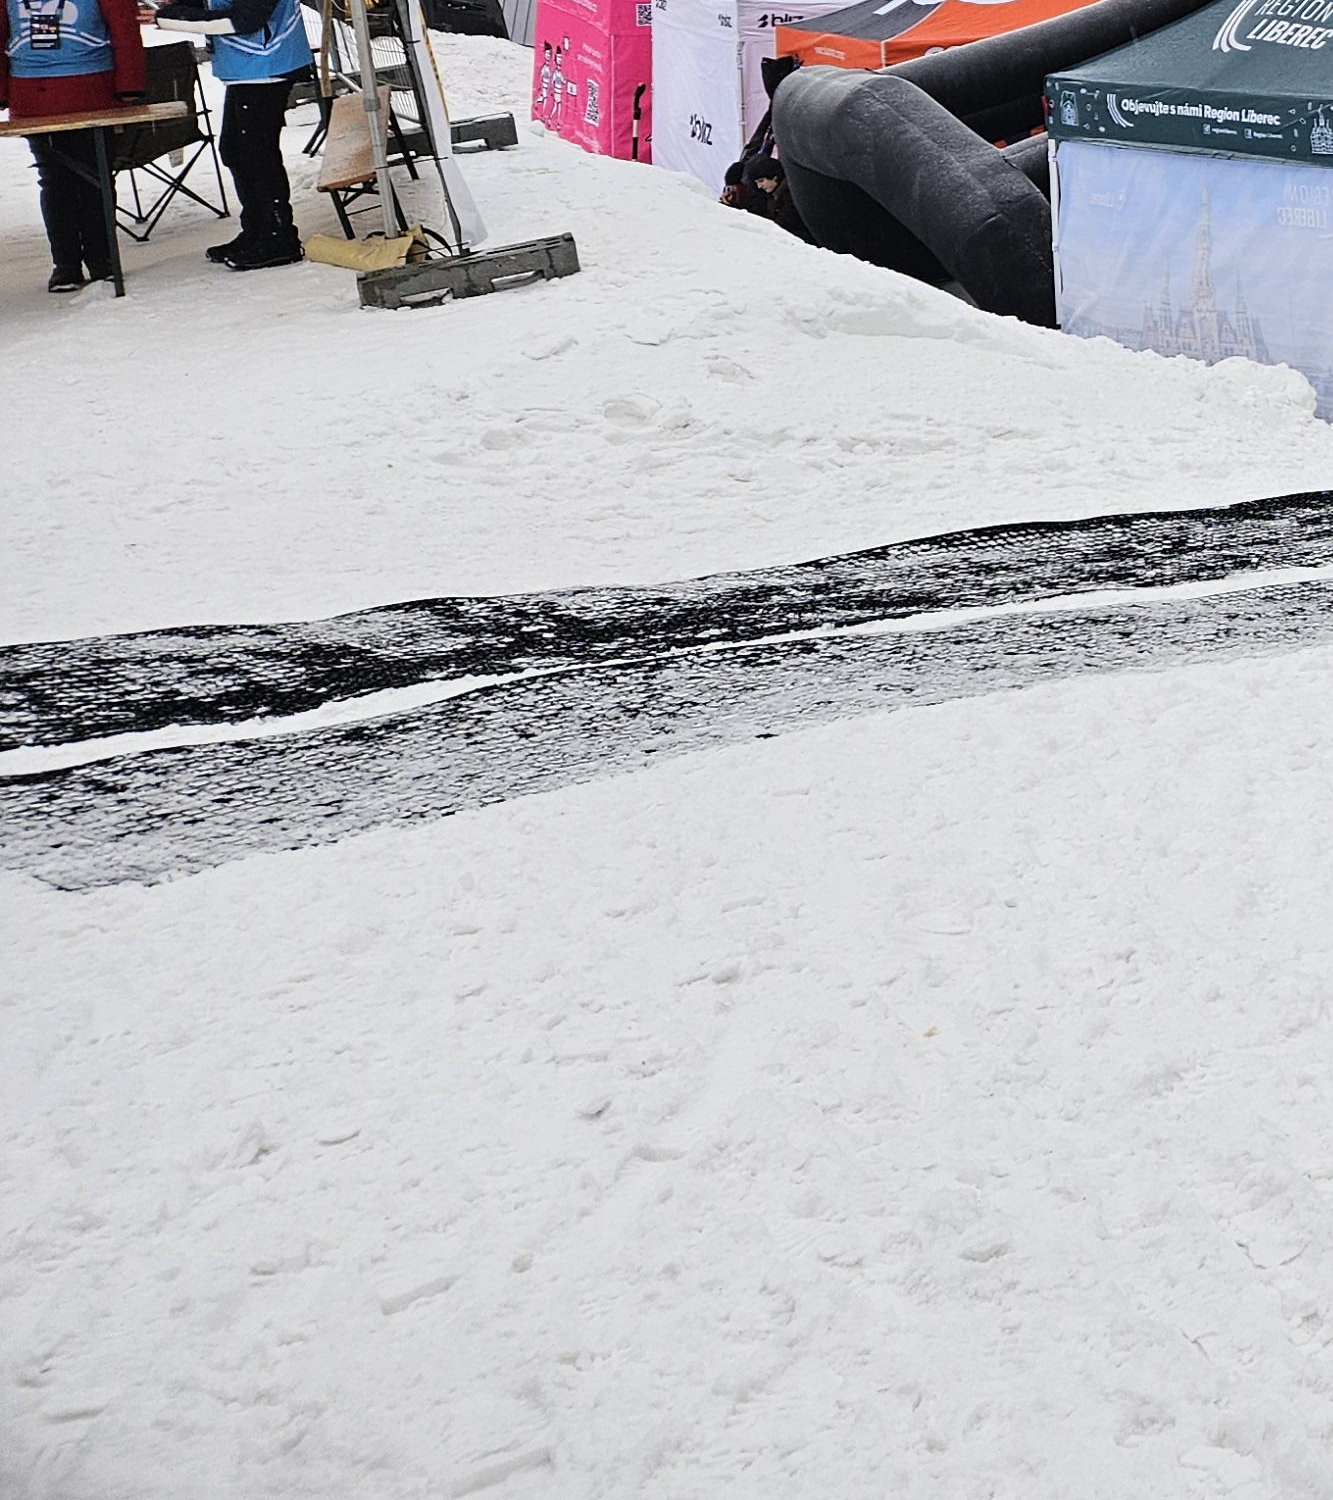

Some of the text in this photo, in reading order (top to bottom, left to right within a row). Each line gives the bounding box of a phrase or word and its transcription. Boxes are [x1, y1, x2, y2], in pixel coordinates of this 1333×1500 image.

[1120, 98, 1281, 126] Objevujte s námi Region Liberec
